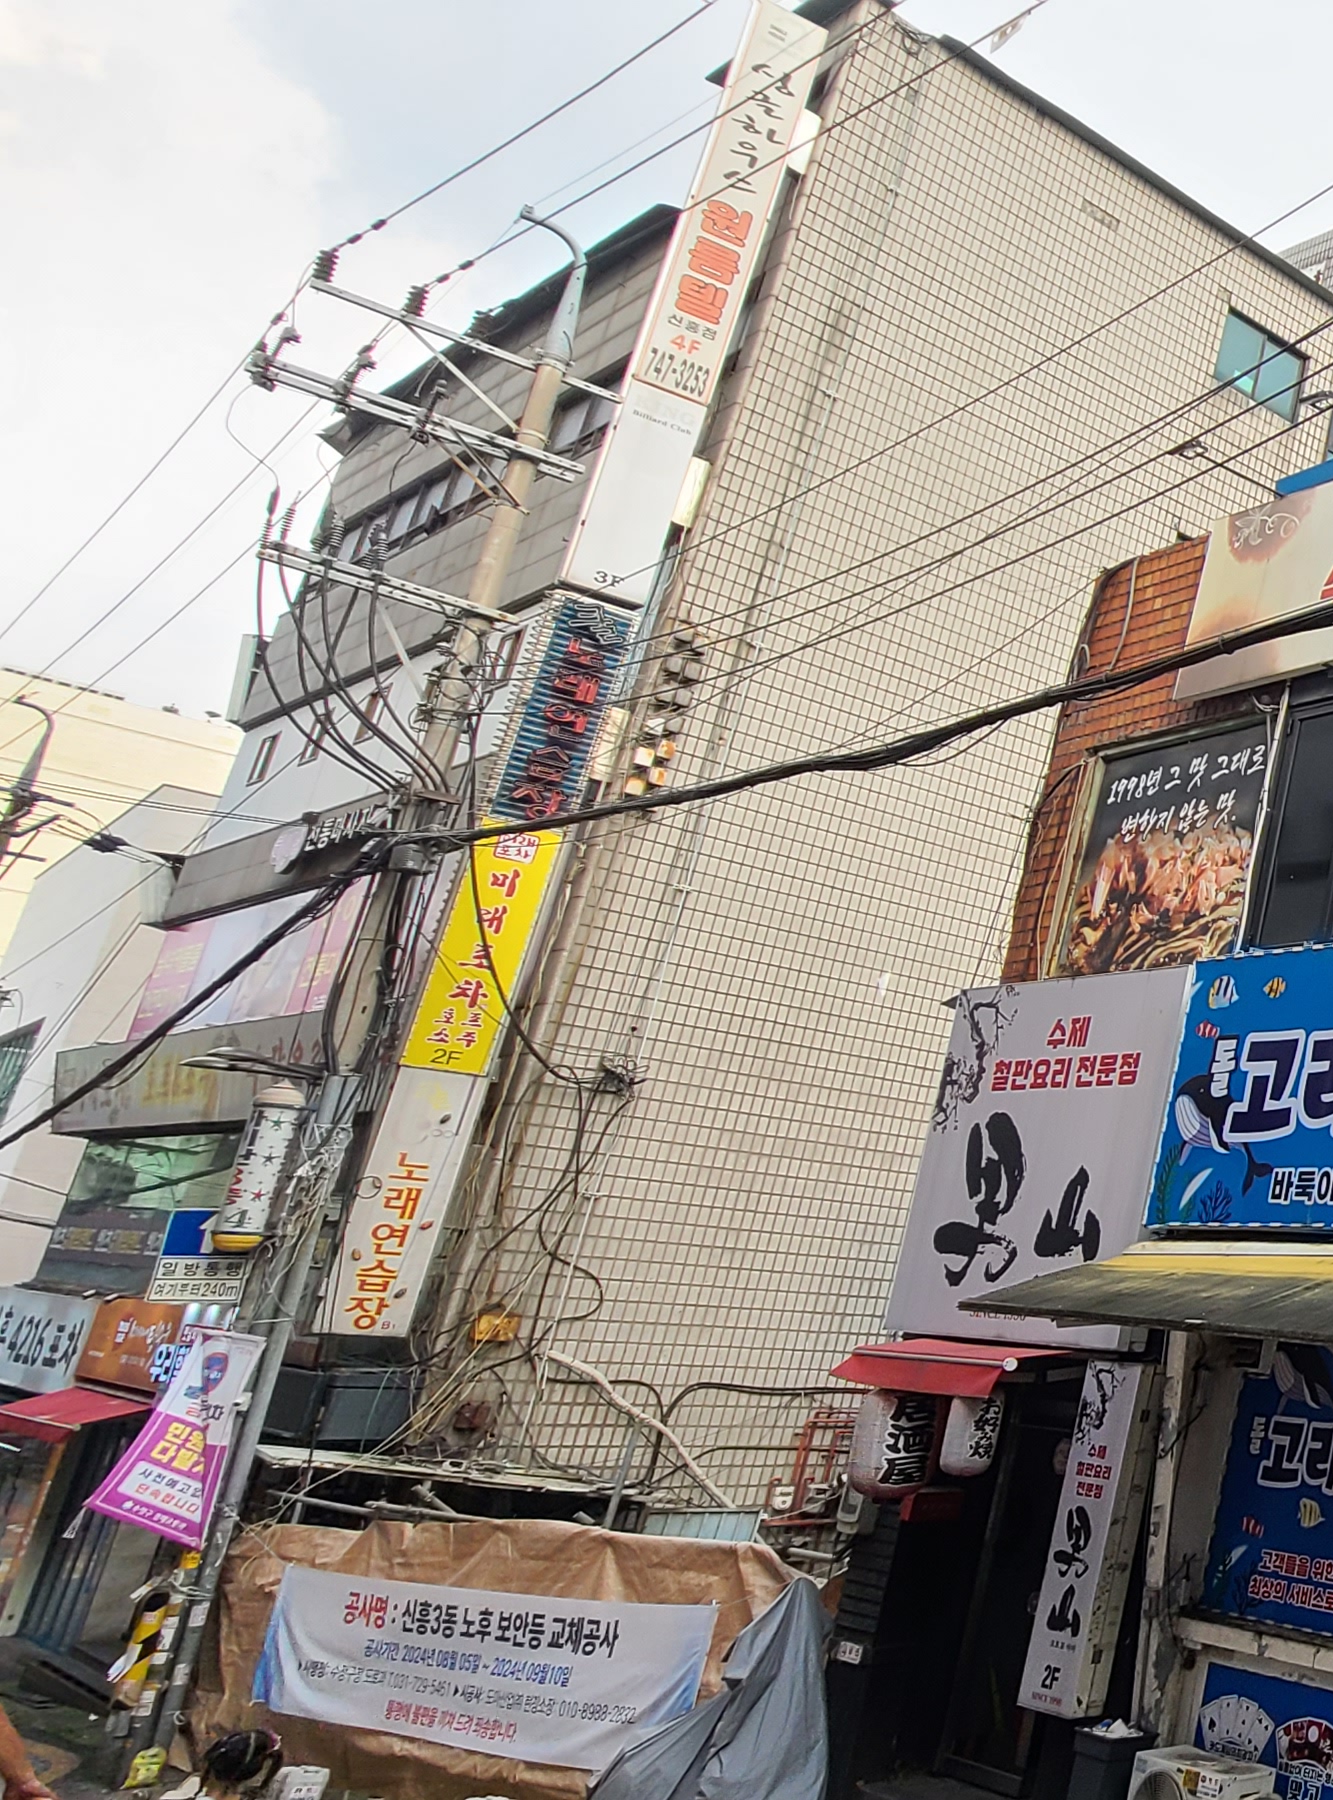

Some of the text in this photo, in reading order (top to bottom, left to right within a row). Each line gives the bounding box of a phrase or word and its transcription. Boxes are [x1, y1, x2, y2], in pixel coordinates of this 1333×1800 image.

[674, 199, 754, 326] 원룸텔
[667, 313, 717, 341] 신흥점
[669, 333, 702, 355] 4F
[644, 347, 710, 399] 747-3253
[593, 570, 626, 588] 3F
[1107, 744, 1266, 805] 1998년 그 맛 그대로
[1120, 805, 1176, 844] 변하지
[1178, 798, 1210, 834] 않는
[1046, 1015, 1093, 1049] 수제
[429, 1048, 465, 1065] 2F
[991, 1051, 1142, 1092] 철판요리 전문점
[1210, 1038, 1239, 1098] 돌
[933, 1110, 1102, 1287] 男山
[344, 1151, 431, 1331] 노래연습장
[161, 1261, 243, 1278] 일방통행
[343, 1590, 390, 1631] 공사명
[401, 1598, 459, 1639] 신흥3동
[459, 1606, 495, 1644] 노후
[494, 1610, 547, 1651] 보안등
[546, 1615, 621, 1659] 교체공사
[1040, 1663, 1062, 1691] 2F
